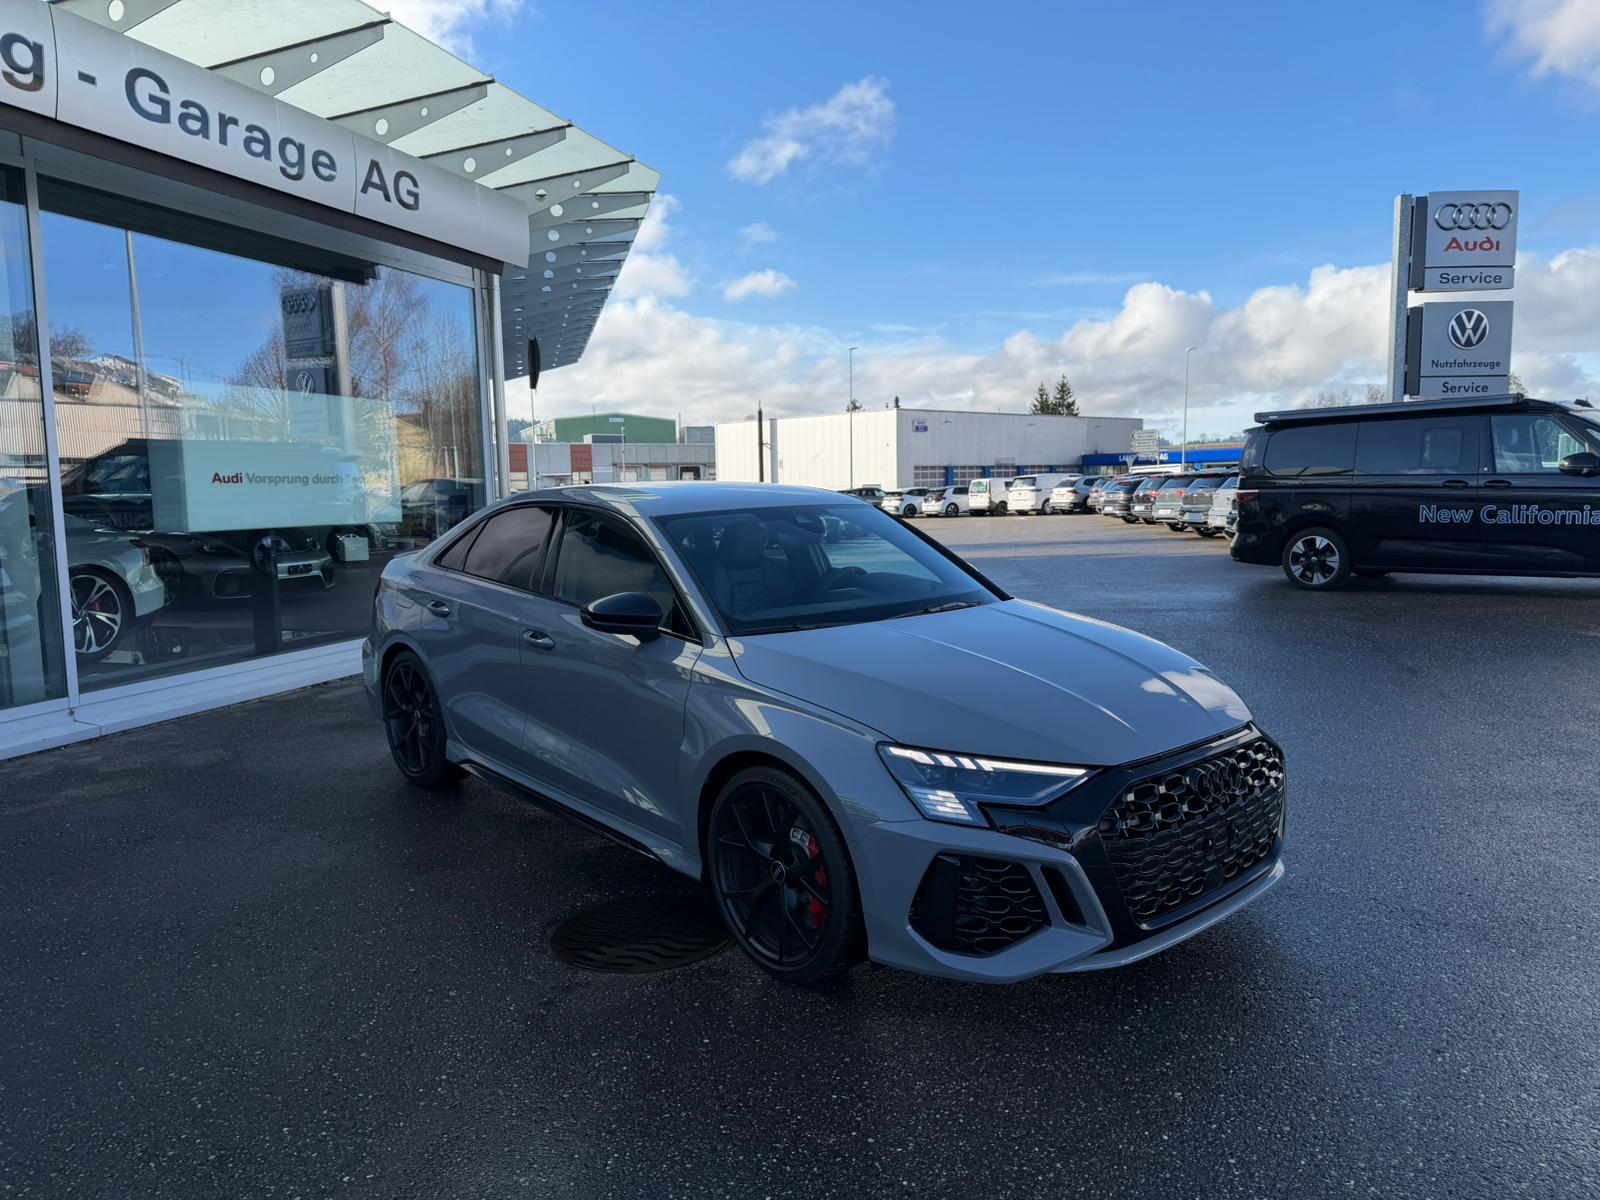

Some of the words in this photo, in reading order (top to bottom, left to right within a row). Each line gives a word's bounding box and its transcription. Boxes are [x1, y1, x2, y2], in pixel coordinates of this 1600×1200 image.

[125, 67, 338, 182] Garage
[360, 158, 420, 212] AG
[1443, 237, 1500, 252] Audi
[1439, 272, 1503, 284] Service
[1431, 359, 1501, 370] Nutzfahrzeuge
[1442, 381, 1489, 394] Service
[212, 472, 243, 484] Audi
[246, 473, 310, 487] Vorsprung
[312, 473, 343, 484] durch
[1419, 505, 1473, 523] New
[1480, 505, 1600, 525] California
